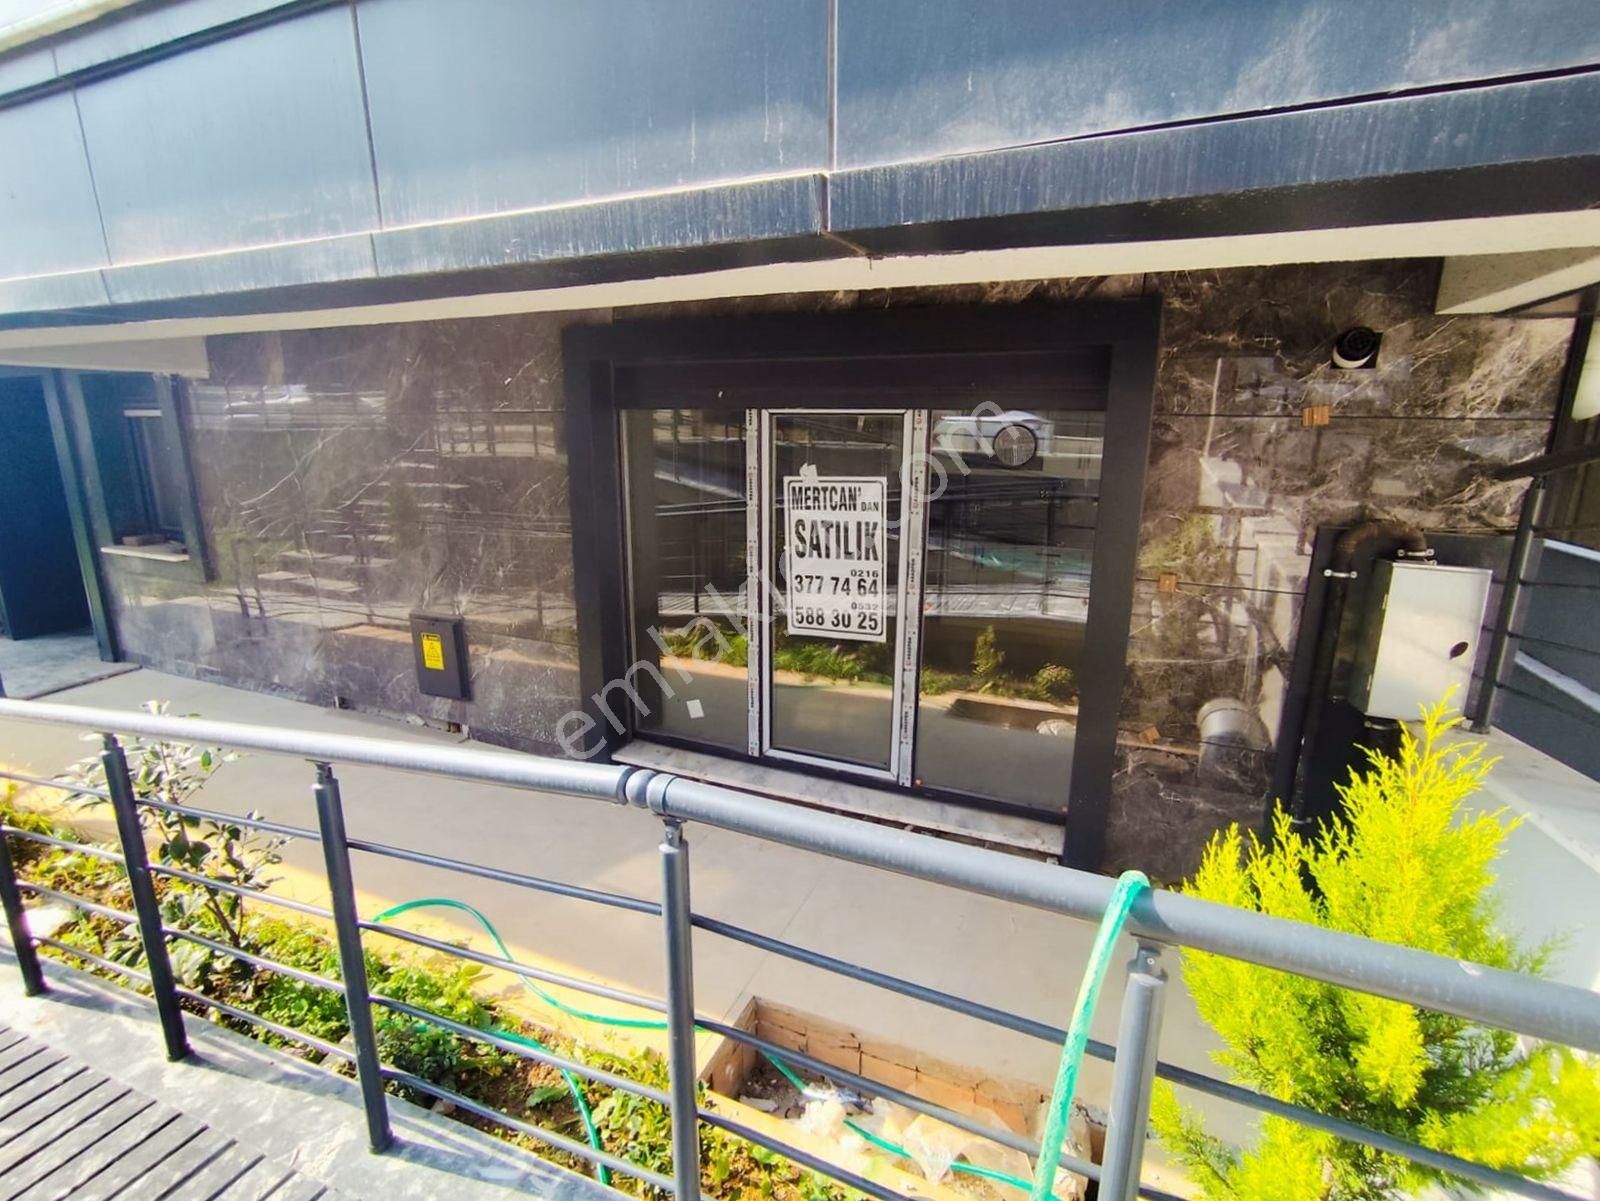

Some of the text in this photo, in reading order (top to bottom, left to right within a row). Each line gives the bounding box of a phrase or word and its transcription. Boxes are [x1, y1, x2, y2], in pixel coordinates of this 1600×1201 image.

[861, 501, 879, 512] DAN
[794, 518, 879, 561] SATILIK
[850, 569, 879, 578] 0216
[794, 574, 879, 597] 377 74 64
[795, 606, 878, 631] 588 30 25
